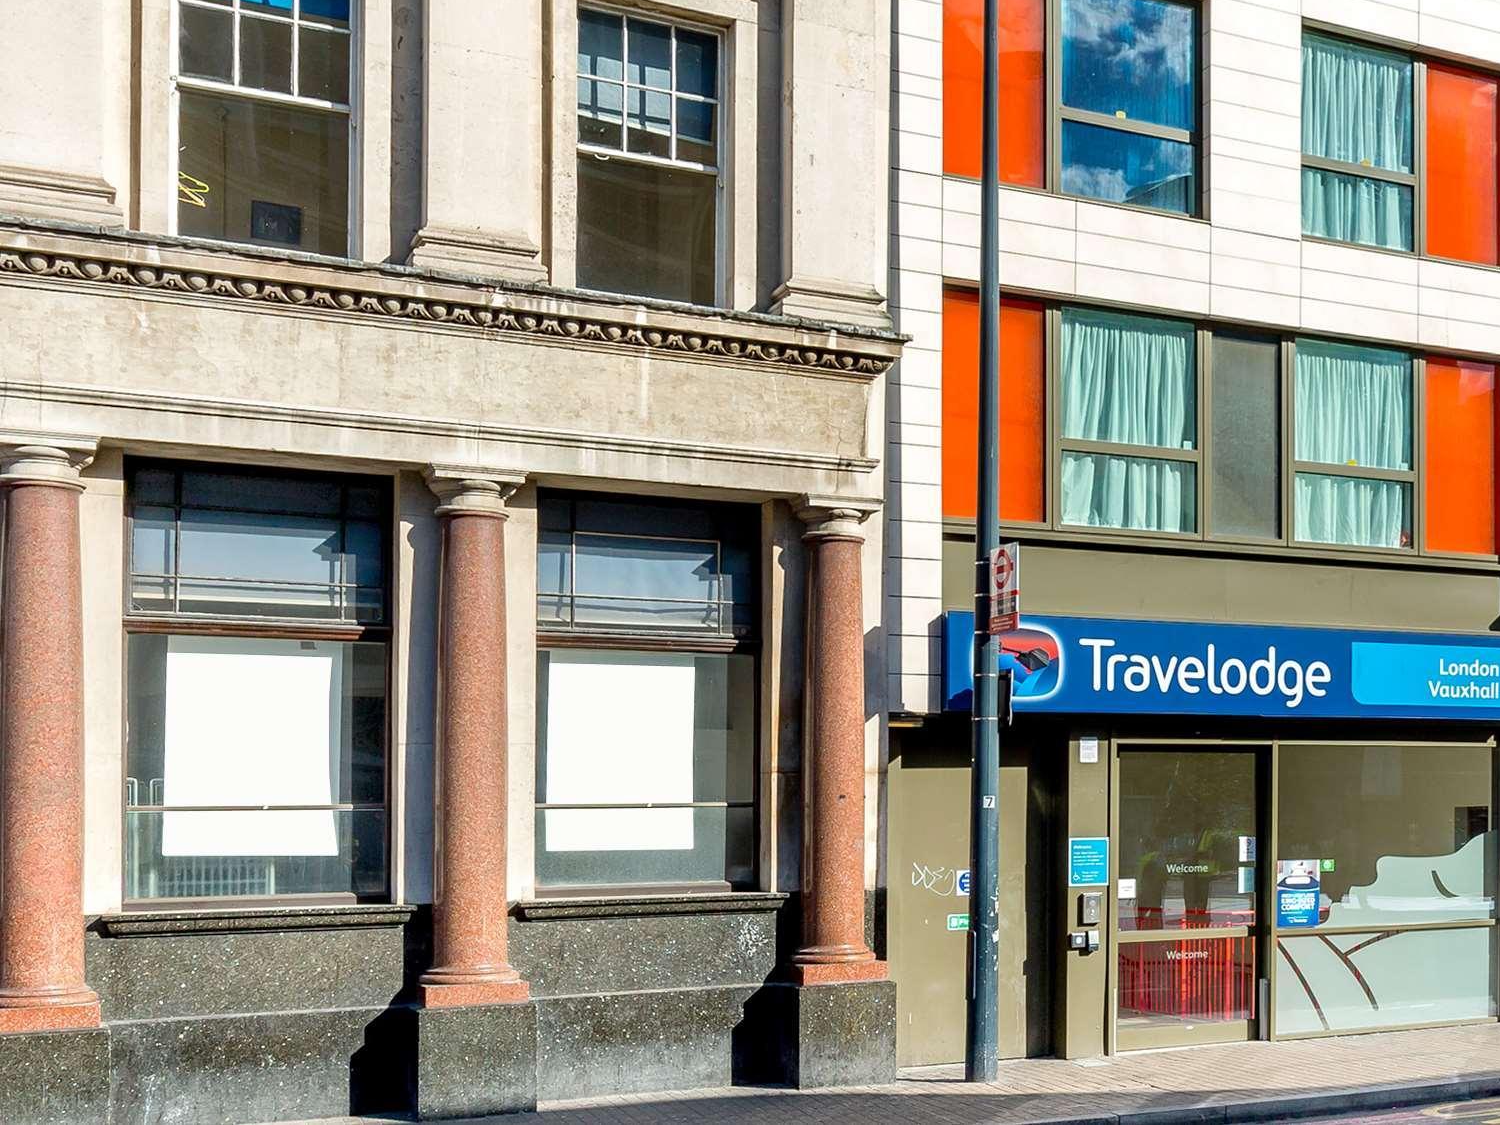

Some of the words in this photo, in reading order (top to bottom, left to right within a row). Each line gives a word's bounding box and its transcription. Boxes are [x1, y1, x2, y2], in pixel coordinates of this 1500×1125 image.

[1079, 638, 1332, 708] Travelodge
[1440, 658, 1500, 677] London
[1428, 680, 1500, 700] Vauxhall
[985, 796, 994, 807] 7
[1166, 863, 1209, 874] Welcome
[1166, 950, 1209, 960] Welcome
